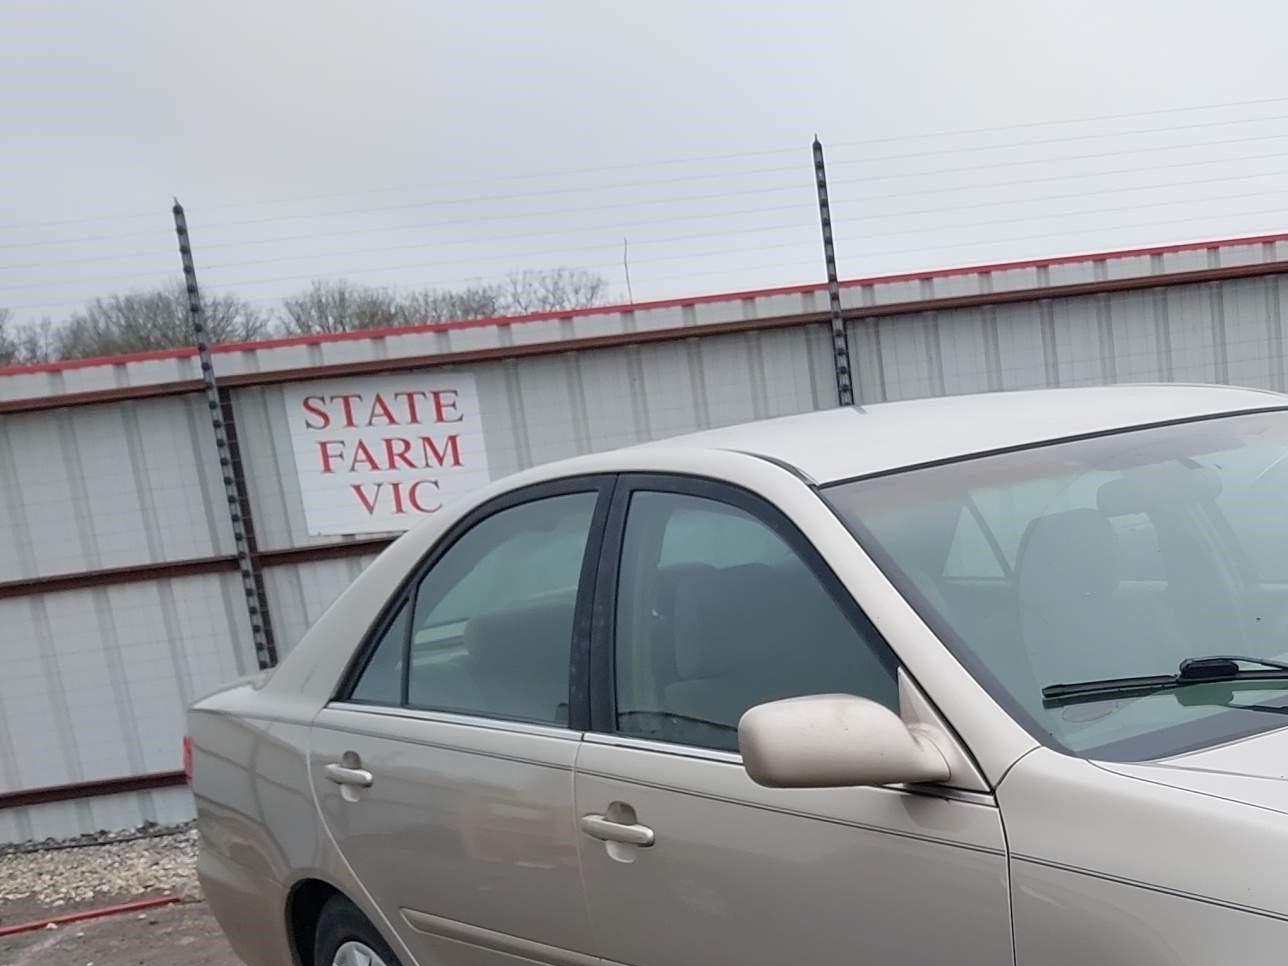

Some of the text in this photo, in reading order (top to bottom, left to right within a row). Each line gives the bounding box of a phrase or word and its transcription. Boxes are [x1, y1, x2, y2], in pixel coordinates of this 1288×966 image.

[302, 389, 464, 430] STATE
[315, 434, 465, 474] FARM
[349, 479, 443, 516] VIC
